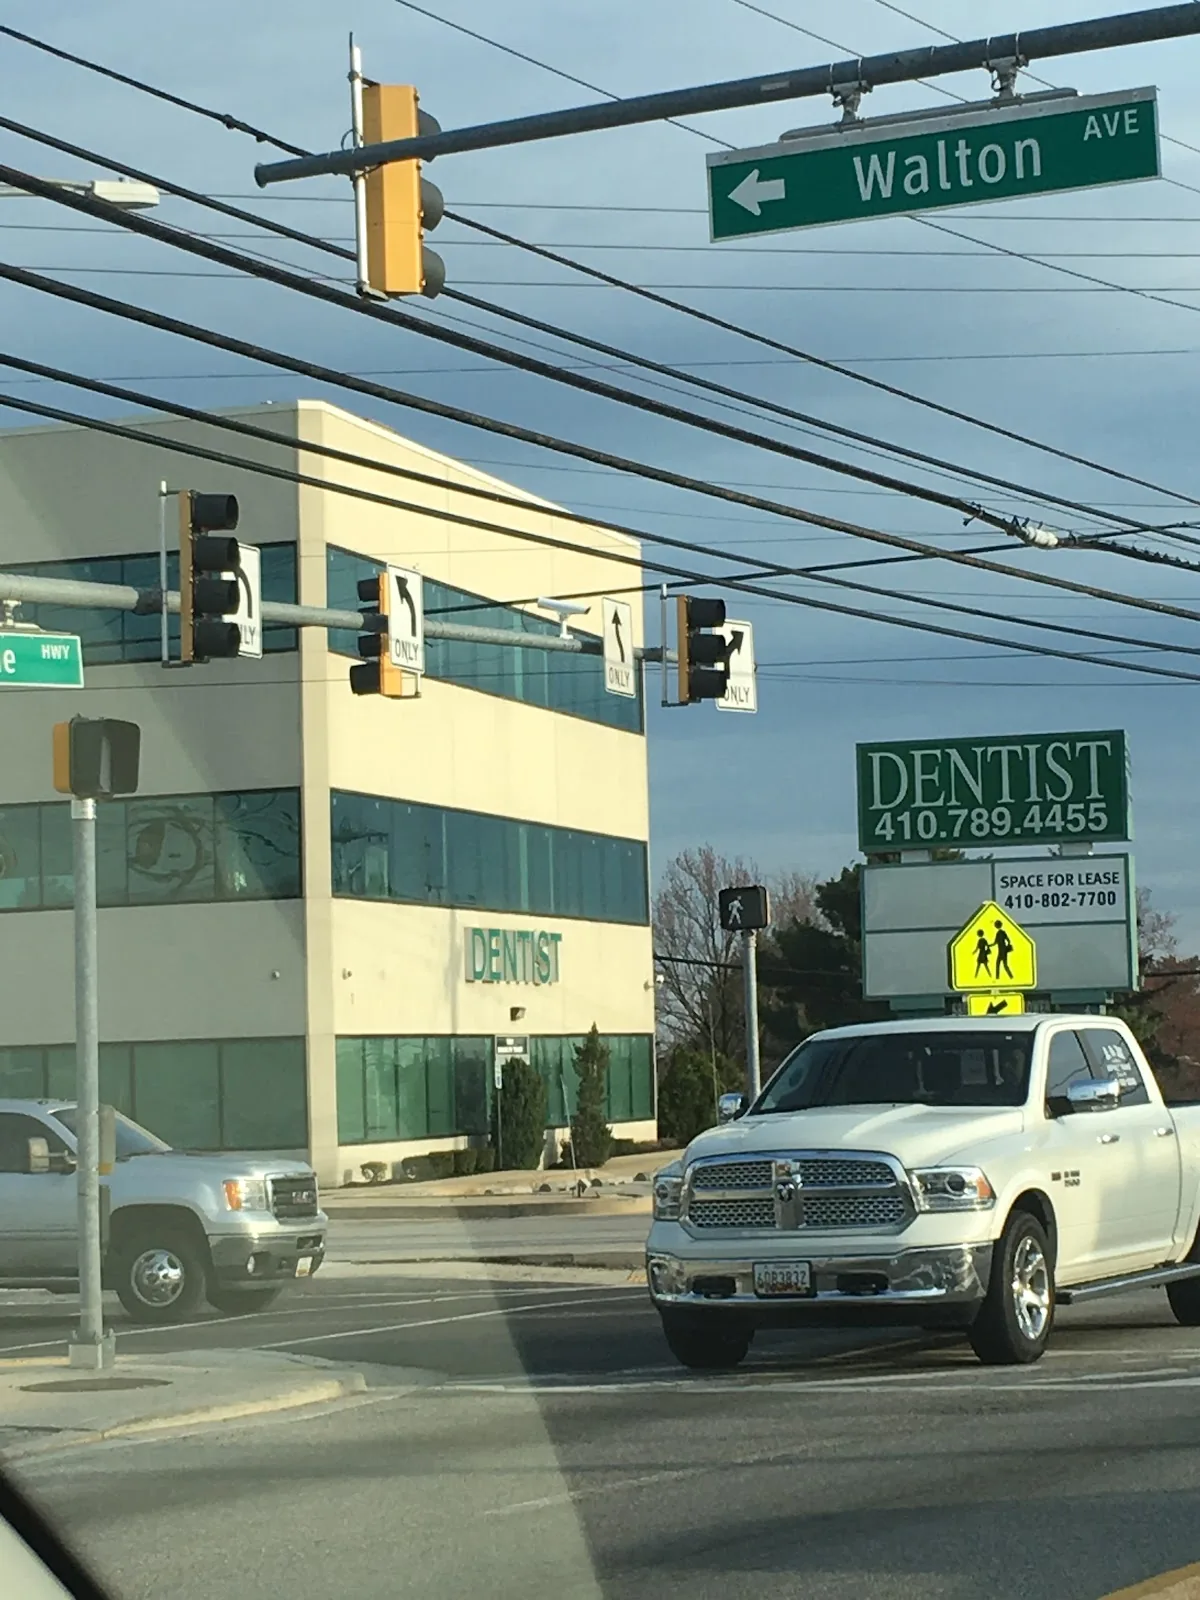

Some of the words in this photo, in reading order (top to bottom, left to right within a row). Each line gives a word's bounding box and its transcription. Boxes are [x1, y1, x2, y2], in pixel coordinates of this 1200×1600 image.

[853, 137, 1042, 201] Walton
[1083, 109, 1140, 141] AVE
[0, 649, 17, 674] e
[41, 644, 70, 660] HWY
[395, 638, 419, 663] ONLY
[608, 667, 630, 688] ONLY
[724, 685, 750, 706] ONLY
[867, 740, 1112, 811] DENTIST
[874, 802, 1109, 841] 410.789.4455
[1000, 874, 1043, 889] SPACE
[1047, 873, 1074, 887] FOR
[1078, 872, 1120, 886] LEASE
[1004, 891, 1117, 909] 410-802-7700
[465, 927, 562, 984] DENTIST
